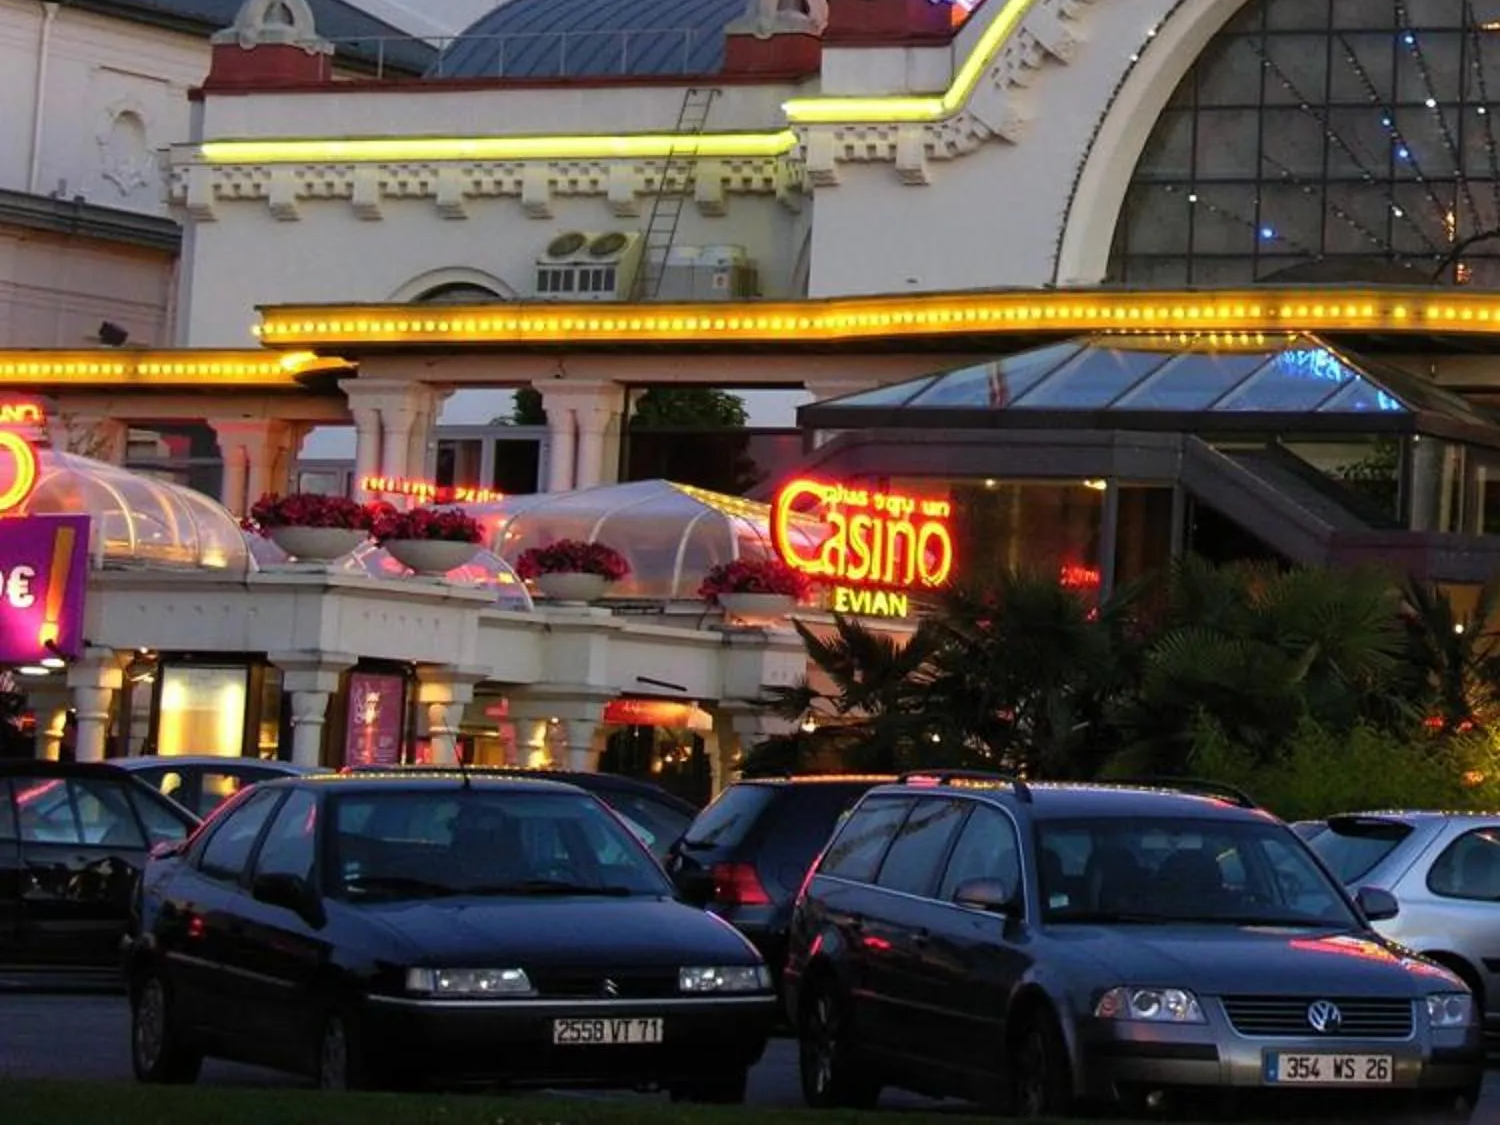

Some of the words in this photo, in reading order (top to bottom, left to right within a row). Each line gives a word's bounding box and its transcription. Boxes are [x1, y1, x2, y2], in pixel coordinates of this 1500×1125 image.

[778, 480, 952, 587] Casino
[834, 586, 908, 618] EVIAN
[1287, 1056, 1320, 1079] 354
[1333, 1057, 1355, 1080] WS
[1365, 1057, 1388, 1080] 26
